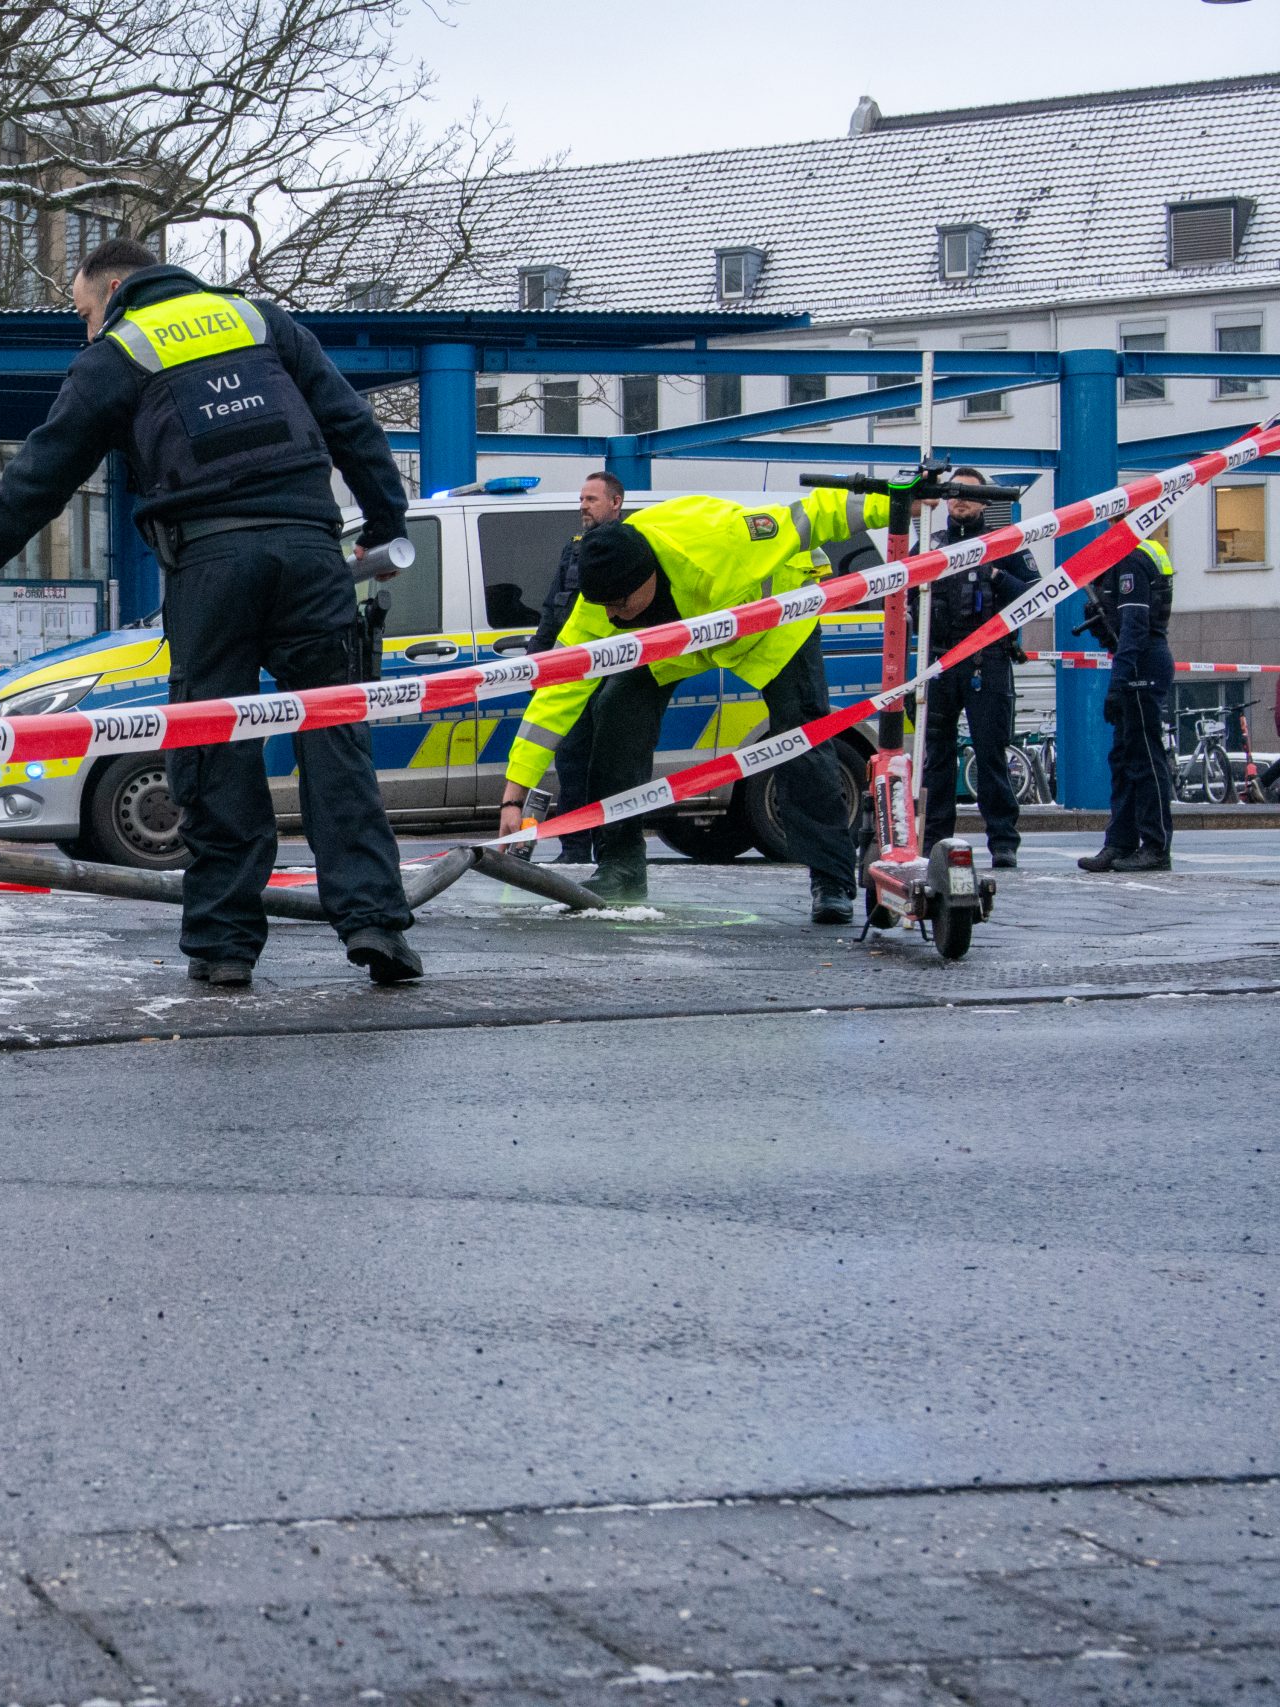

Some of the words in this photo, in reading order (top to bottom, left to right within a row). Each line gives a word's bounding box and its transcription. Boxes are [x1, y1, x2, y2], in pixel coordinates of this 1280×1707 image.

[153, 311, 239, 347] POLIZEI
[206, 373, 241, 394] VU
[199, 394, 265, 420] Team
[1009, 576, 1071, 625] POLIZEI
[94, 712, 161, 743] POLIZEI
[237, 699, 300, 727] POLIZEI
[368, 683, 421, 710] POLIZEI
[591, 641, 638, 671] POLIZEI
[691, 618, 734, 646] POLIZEI
[781, 593, 824, 622] POLIZEI
[868, 571, 906, 597] POLIZEI
[947, 546, 984, 571] POLIZEI
[1023, 521, 1058, 546] POLIZEI
[1094, 497, 1127, 520] POLIZEI
